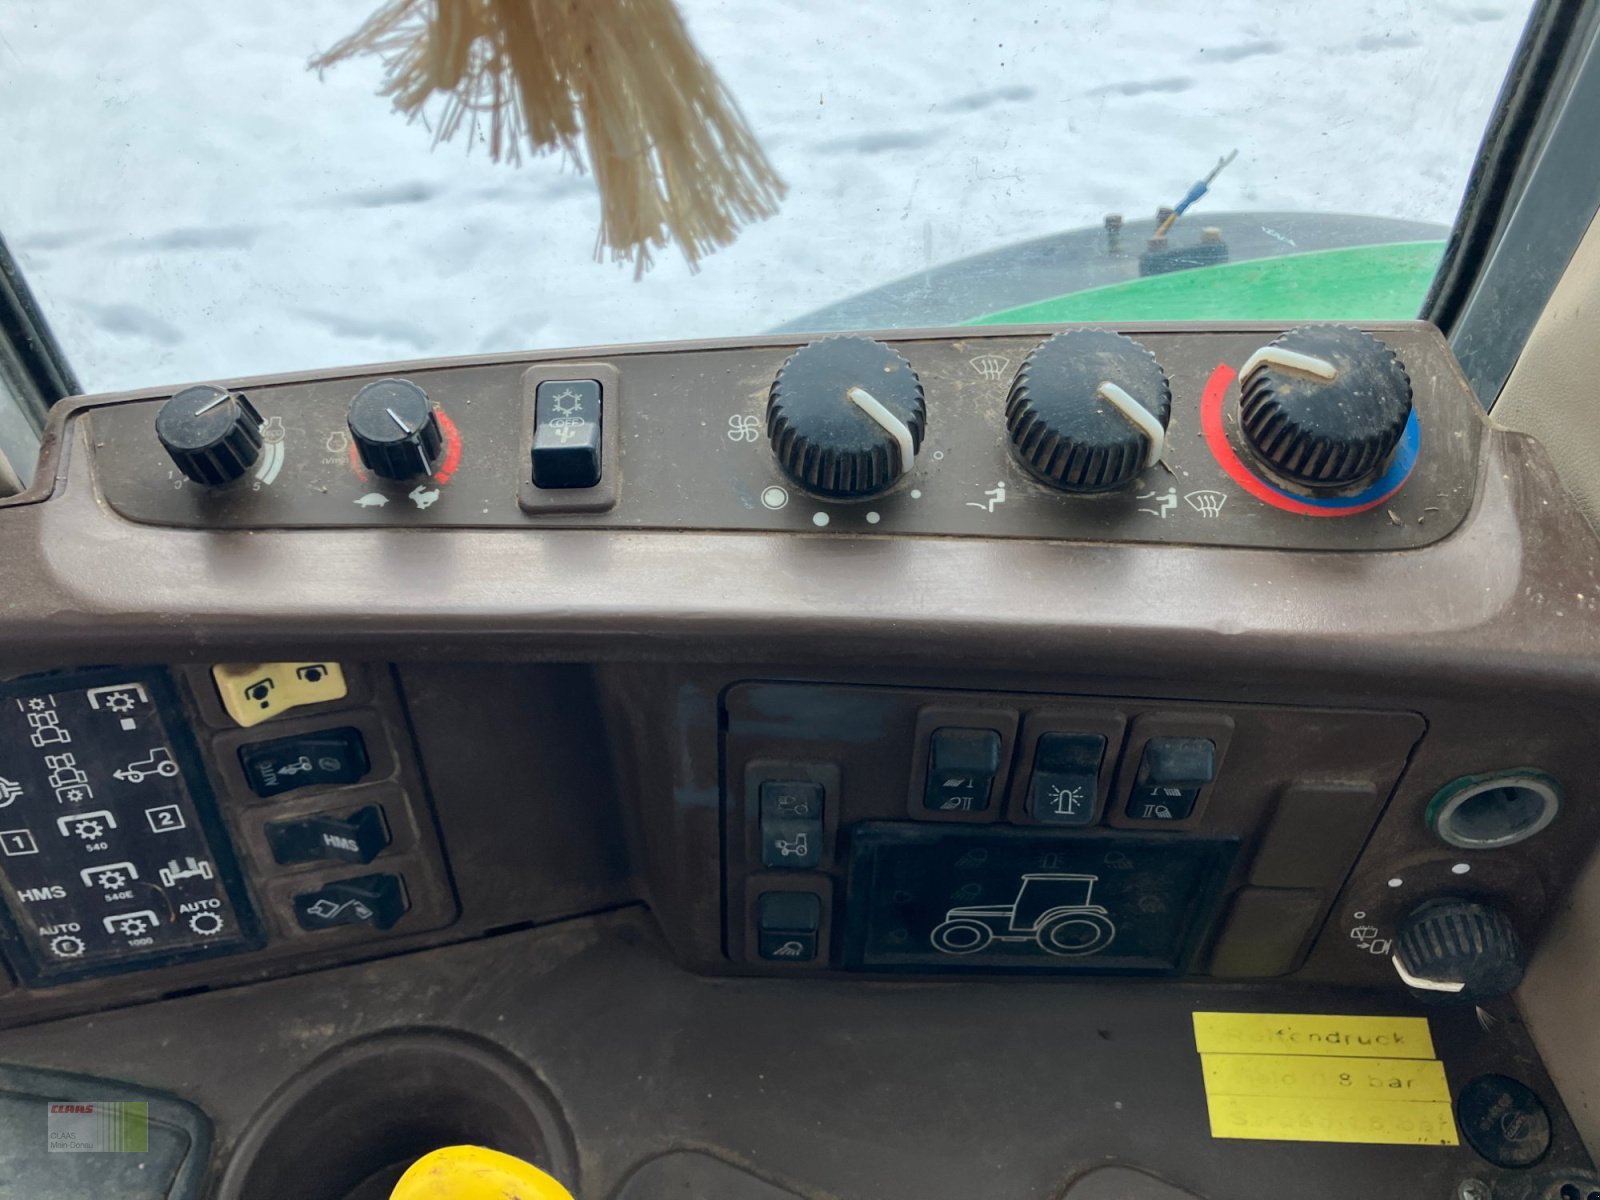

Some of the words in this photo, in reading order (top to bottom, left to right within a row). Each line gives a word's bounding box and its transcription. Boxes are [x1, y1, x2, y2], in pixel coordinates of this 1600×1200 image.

[555, 419, 580, 428] OFF
[252, 482, 262, 492] 5
[158, 811, 174, 826] 2
[11, 835, 25, 850] 1
[85, 841, 109, 853] 540
[322, 833, 359, 852] HMS
[17, 885, 67, 903] HMS
[104, 890, 135, 902] 540E
[179, 898, 221, 914] AUTO
[39, 922, 81, 936] AUTO
[128, 937, 154, 947] 1000
